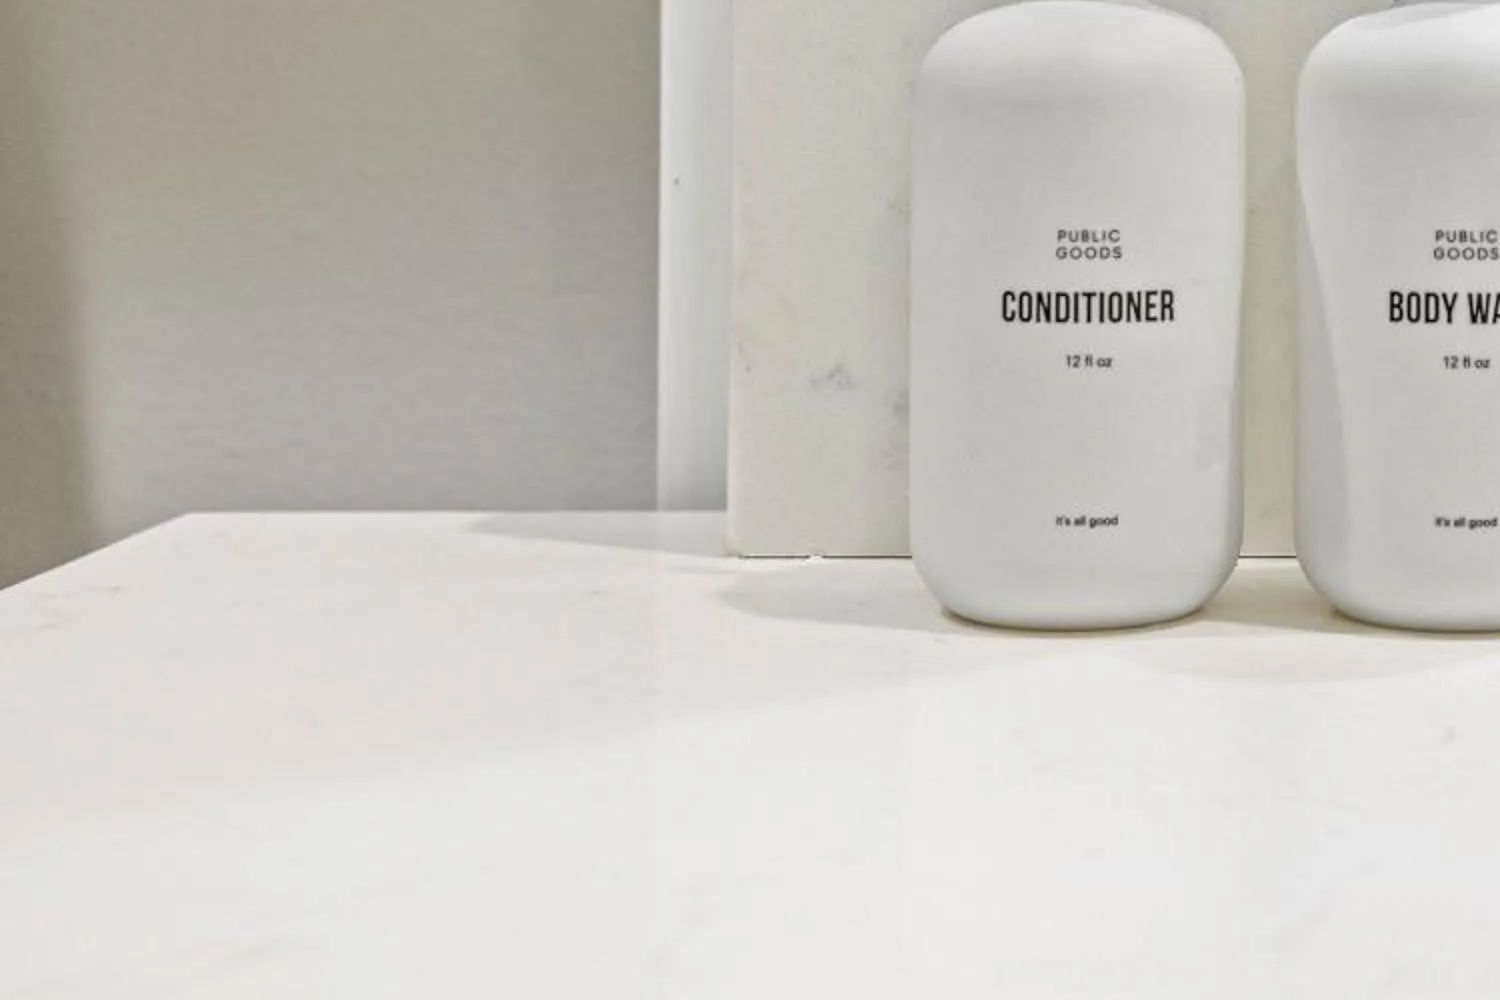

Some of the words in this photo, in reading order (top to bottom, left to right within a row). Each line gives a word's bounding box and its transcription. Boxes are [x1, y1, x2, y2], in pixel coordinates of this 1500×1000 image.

[1056, 229, 1121, 243] PUBLIC
[1434, 229, 1498, 243] PUBLIC
[1055, 246, 1122, 260] GOODS
[1433, 247, 1500, 261] GOODS
[1001, 289, 1175, 323] CONDITIONER
[1388, 290, 1458, 325] BODY
[1065, 354, 1081, 369] 12
[1084, 354, 1093, 369] fl
[1096, 358, 1113, 369] oz
[1443, 355, 1459, 369] 12
[1462, 355, 1471, 369] fl
[1474, 359, 1491, 370] oz
[1073, 515, 1086, 527] all
[1089, 515, 1119, 529] good
[1453, 516, 1466, 527] all
[1468, 516, 1498, 530] good
